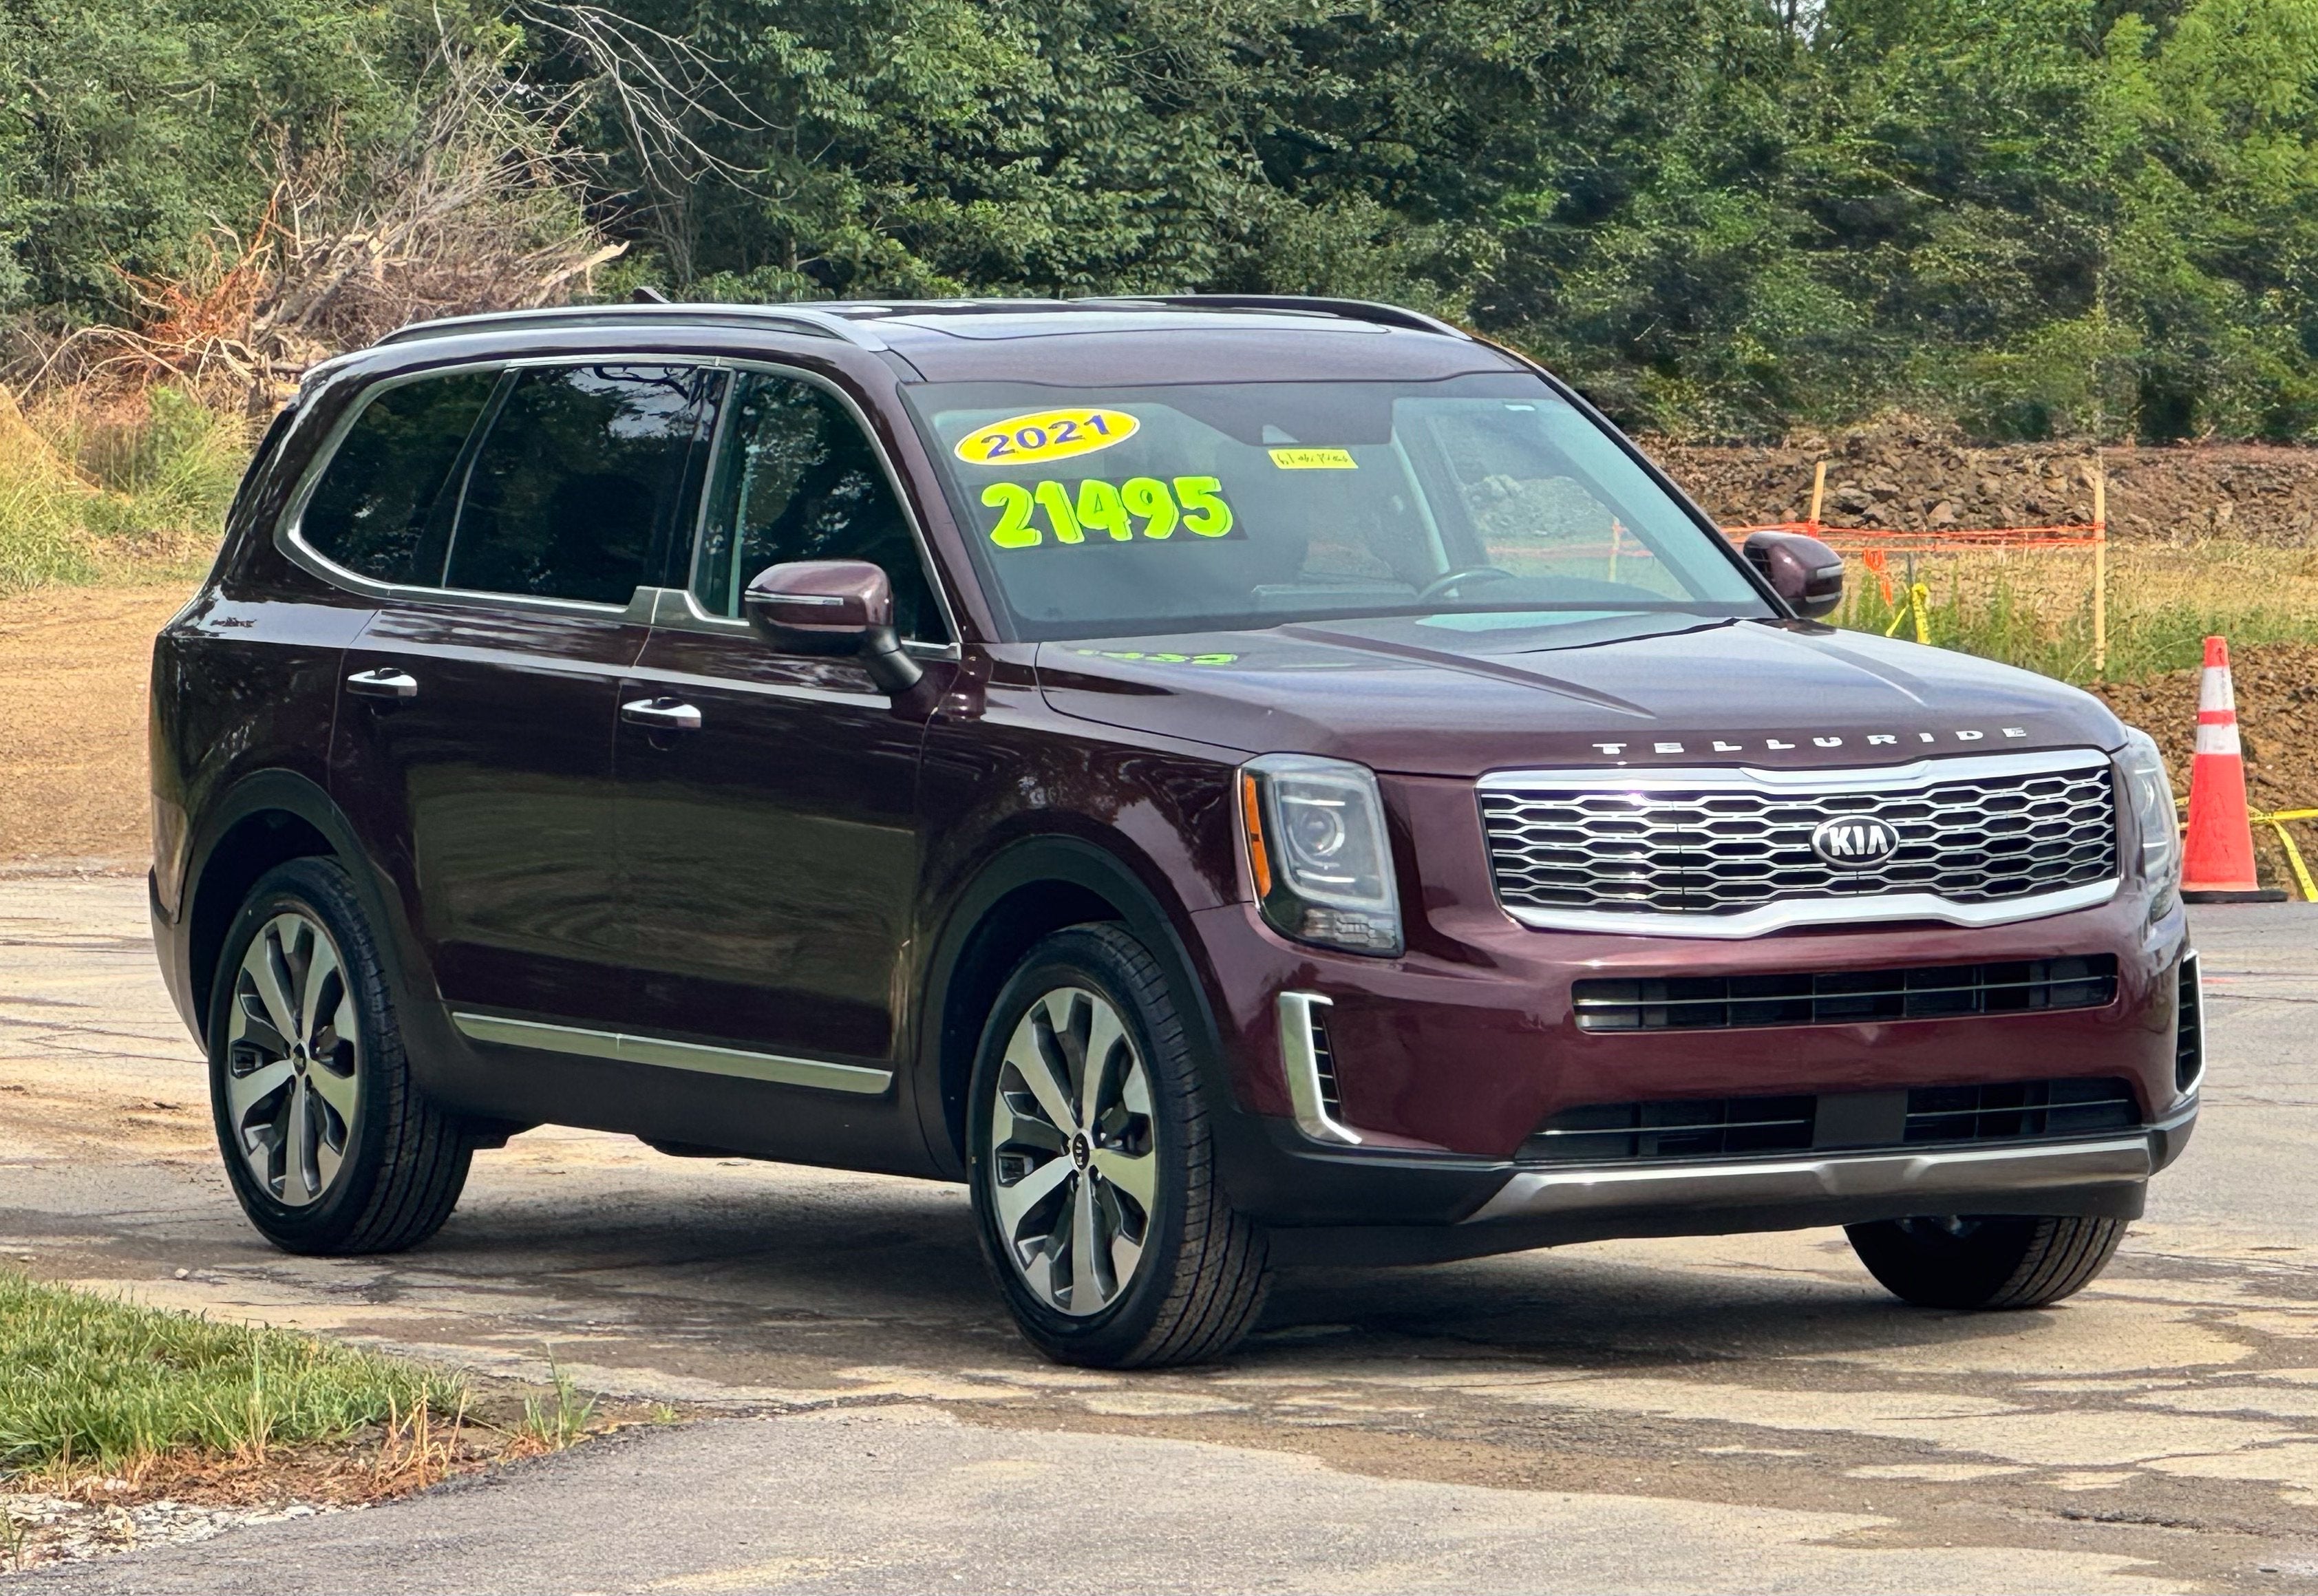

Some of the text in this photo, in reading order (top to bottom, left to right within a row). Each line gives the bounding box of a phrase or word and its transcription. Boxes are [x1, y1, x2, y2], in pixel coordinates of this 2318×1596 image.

[981, 414, 1110, 459] 2021
[981, 476, 1233, 548] 21495
[1593, 727, 2026, 756] TELLURIDE
[1829, 825, 1889, 856] KIA
